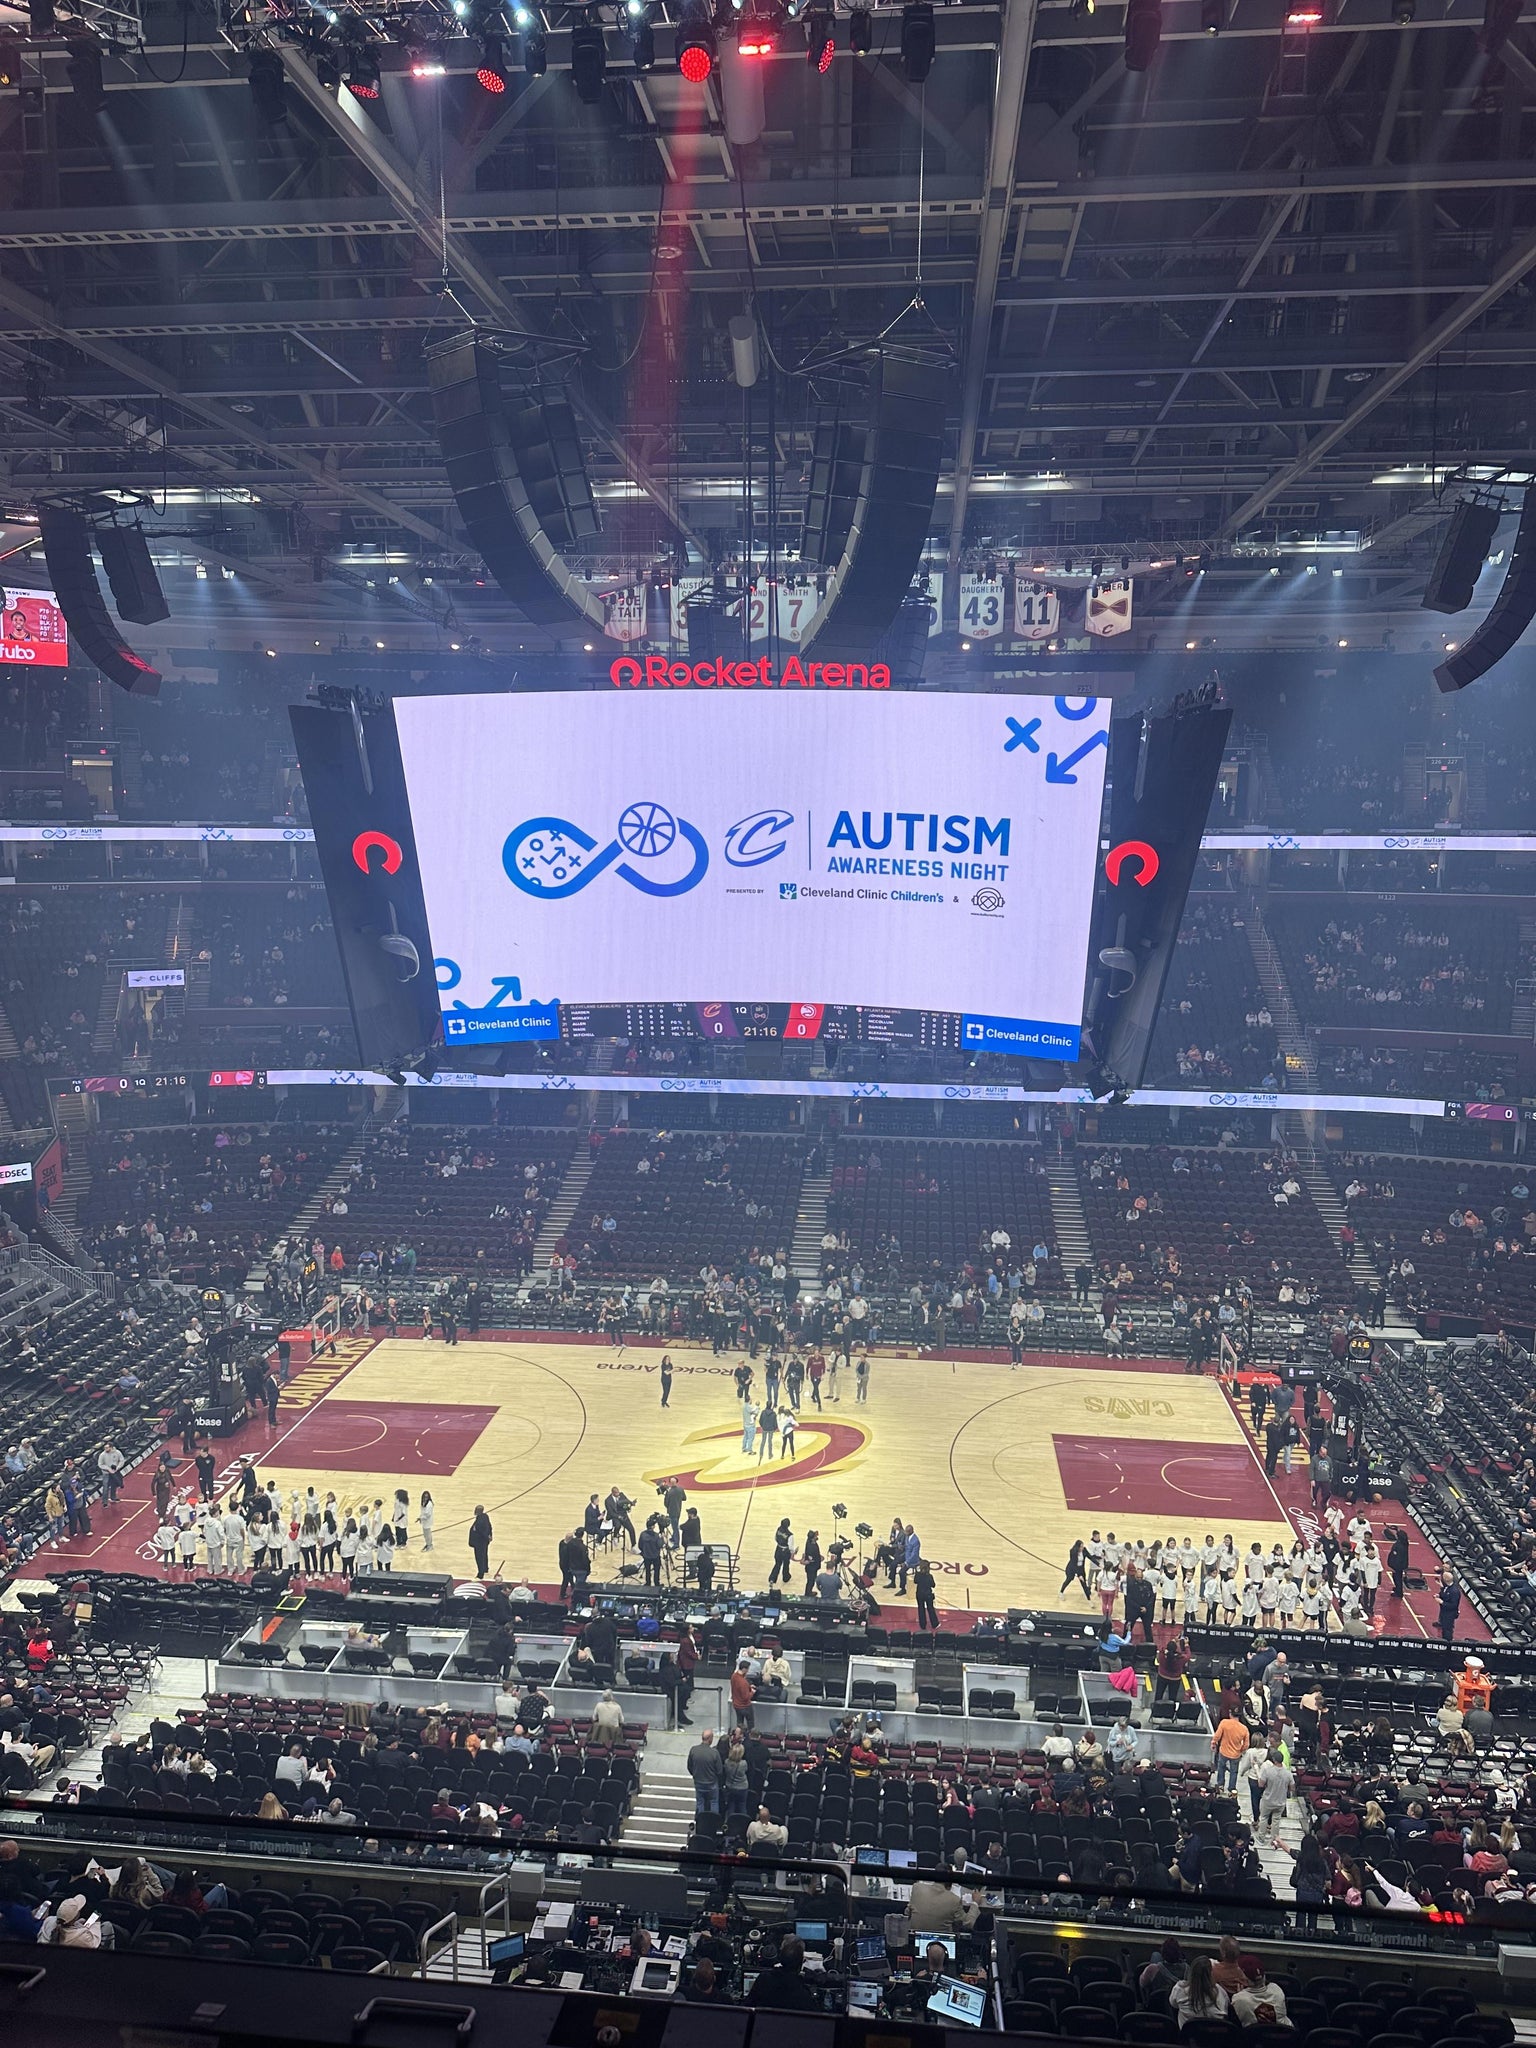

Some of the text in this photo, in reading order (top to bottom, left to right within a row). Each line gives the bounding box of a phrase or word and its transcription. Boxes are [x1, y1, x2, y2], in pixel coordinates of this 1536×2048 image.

[783, 589, 809, 597] SMITH
[961, 585, 1004, 594] DAUGHERTY
[618, 607, 643, 618] TAIT
[788, 599, 803, 628] 7
[963, 596, 999, 626] 43
[1023, 596, 1051, 625] 11
[0, 643, 36, 661] fubo
[646, 655, 890, 688] Rocket Arena
[827, 810, 1011, 857] AUTISM
[827, 856, 1010, 882] AWARENESS NIGHT
[800, 886, 960, 903] Cleveland Clinic Children's &
[149, 974, 183, 982] CLIFFS
[468, 1016, 552, 1032] Cleveland Clinic
[714, 1022, 723, 1034] 0
[743, 1026, 778, 1037] 21:16
[797, 1023, 806, 1035] 0
[986, 1027, 1073, 1047] Cleveland Clinic
[74, 1085, 81, 1093] 0
[119, 1073, 222, 1089] 0 1Q 21:16 0
[1504, 1109, 1513, 1119] 0
[1083, 1396, 1176, 1418] CAVS
[194, 1416, 222, 1427] nbase
